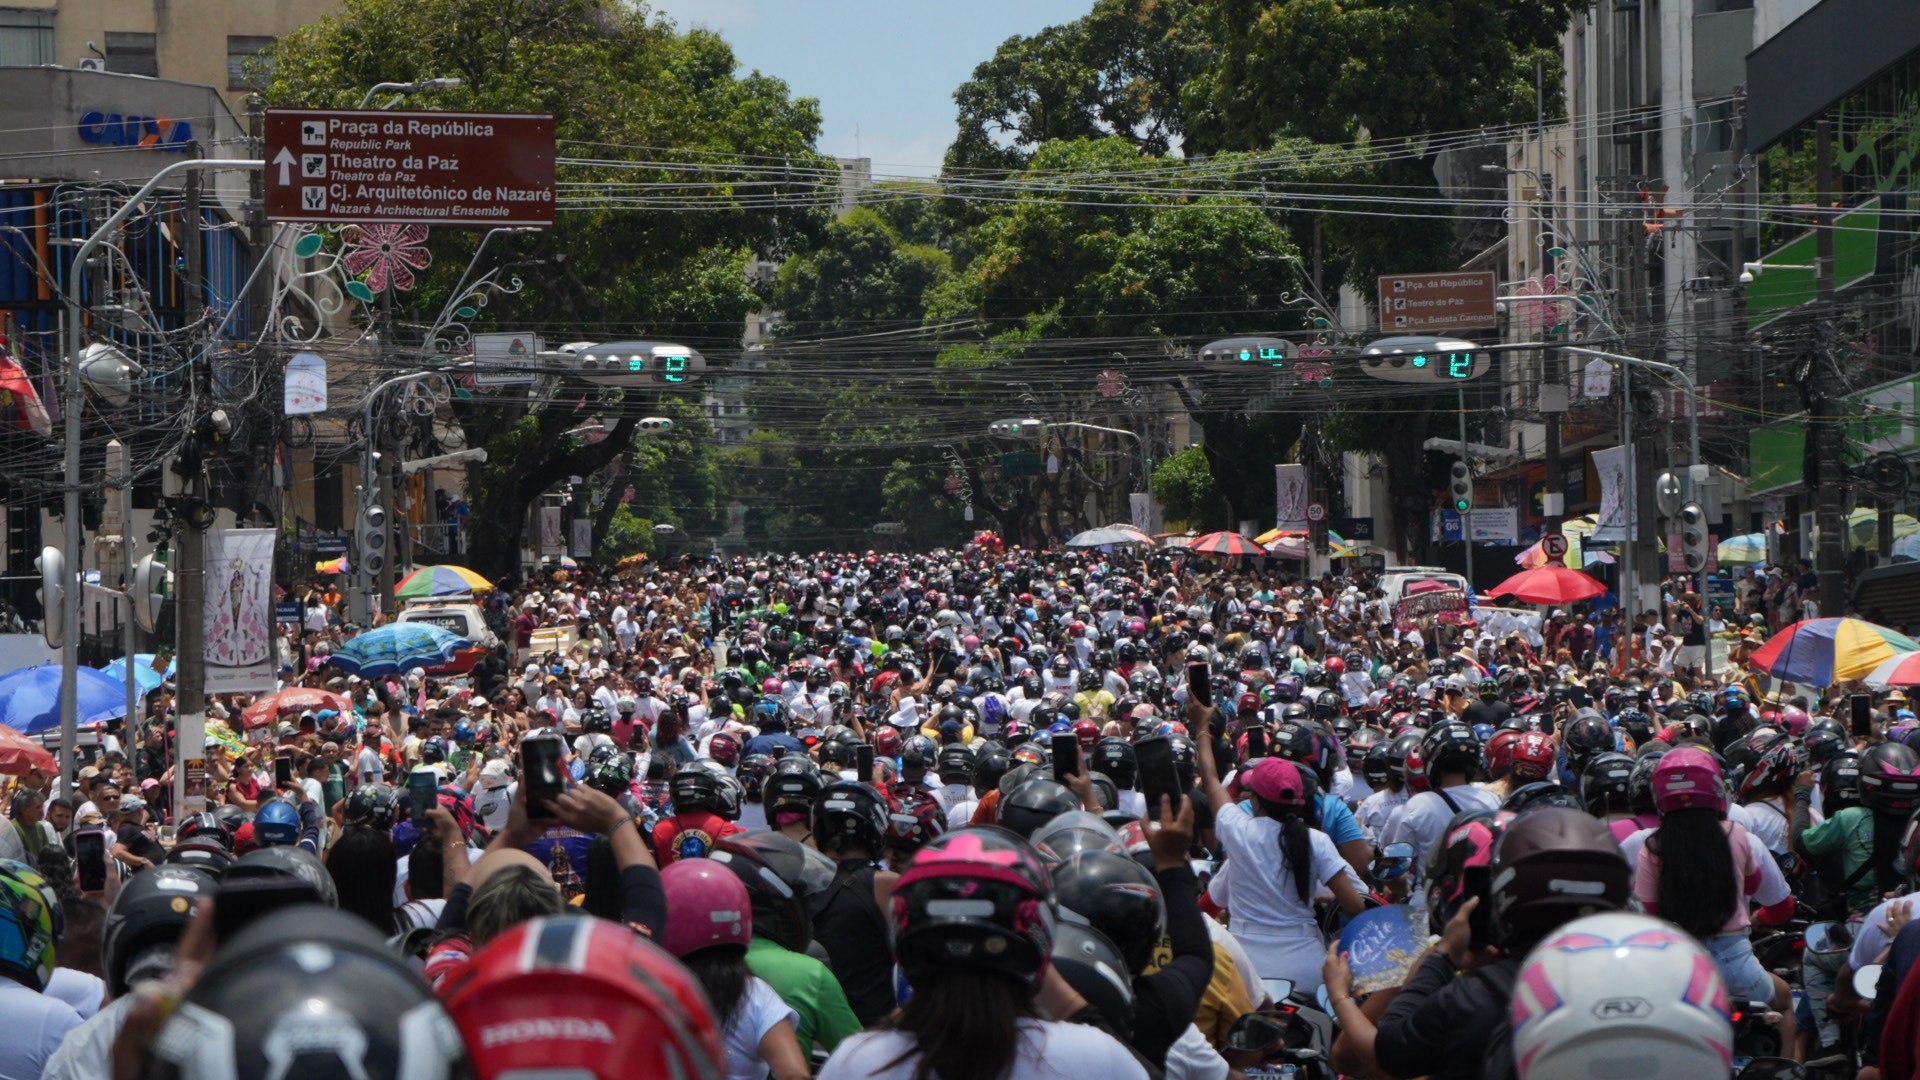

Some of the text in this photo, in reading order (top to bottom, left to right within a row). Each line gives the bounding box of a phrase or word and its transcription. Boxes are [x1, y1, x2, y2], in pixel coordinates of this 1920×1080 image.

[78, 111, 193, 153] CAIXA
[329, 119, 494, 139] Praça da República
[330, 138, 412, 152] Republic Park
[331, 154, 459, 171] Theatro da Paz
[330, 171, 416, 182] Theatro da Paz
[330, 184, 551, 203] Cj. Arquitetônico de Nazaré
[330, 203, 510, 217] Nazaré Architectural Ensemble
[1407, 278, 1484, 290] Pça. da República
[1408, 298, 1464, 307] Teatro da Paz
[1408, 314, 1493, 325] Pça. Batista Campos
[1310, 506, 1322, 515] 50
[1355, 523, 1368, 534] 5G
[1445, 522, 1459, 531] 06
[1603, 999, 1640, 1015] FLY
[480, 1017, 614, 1049] HONDA
